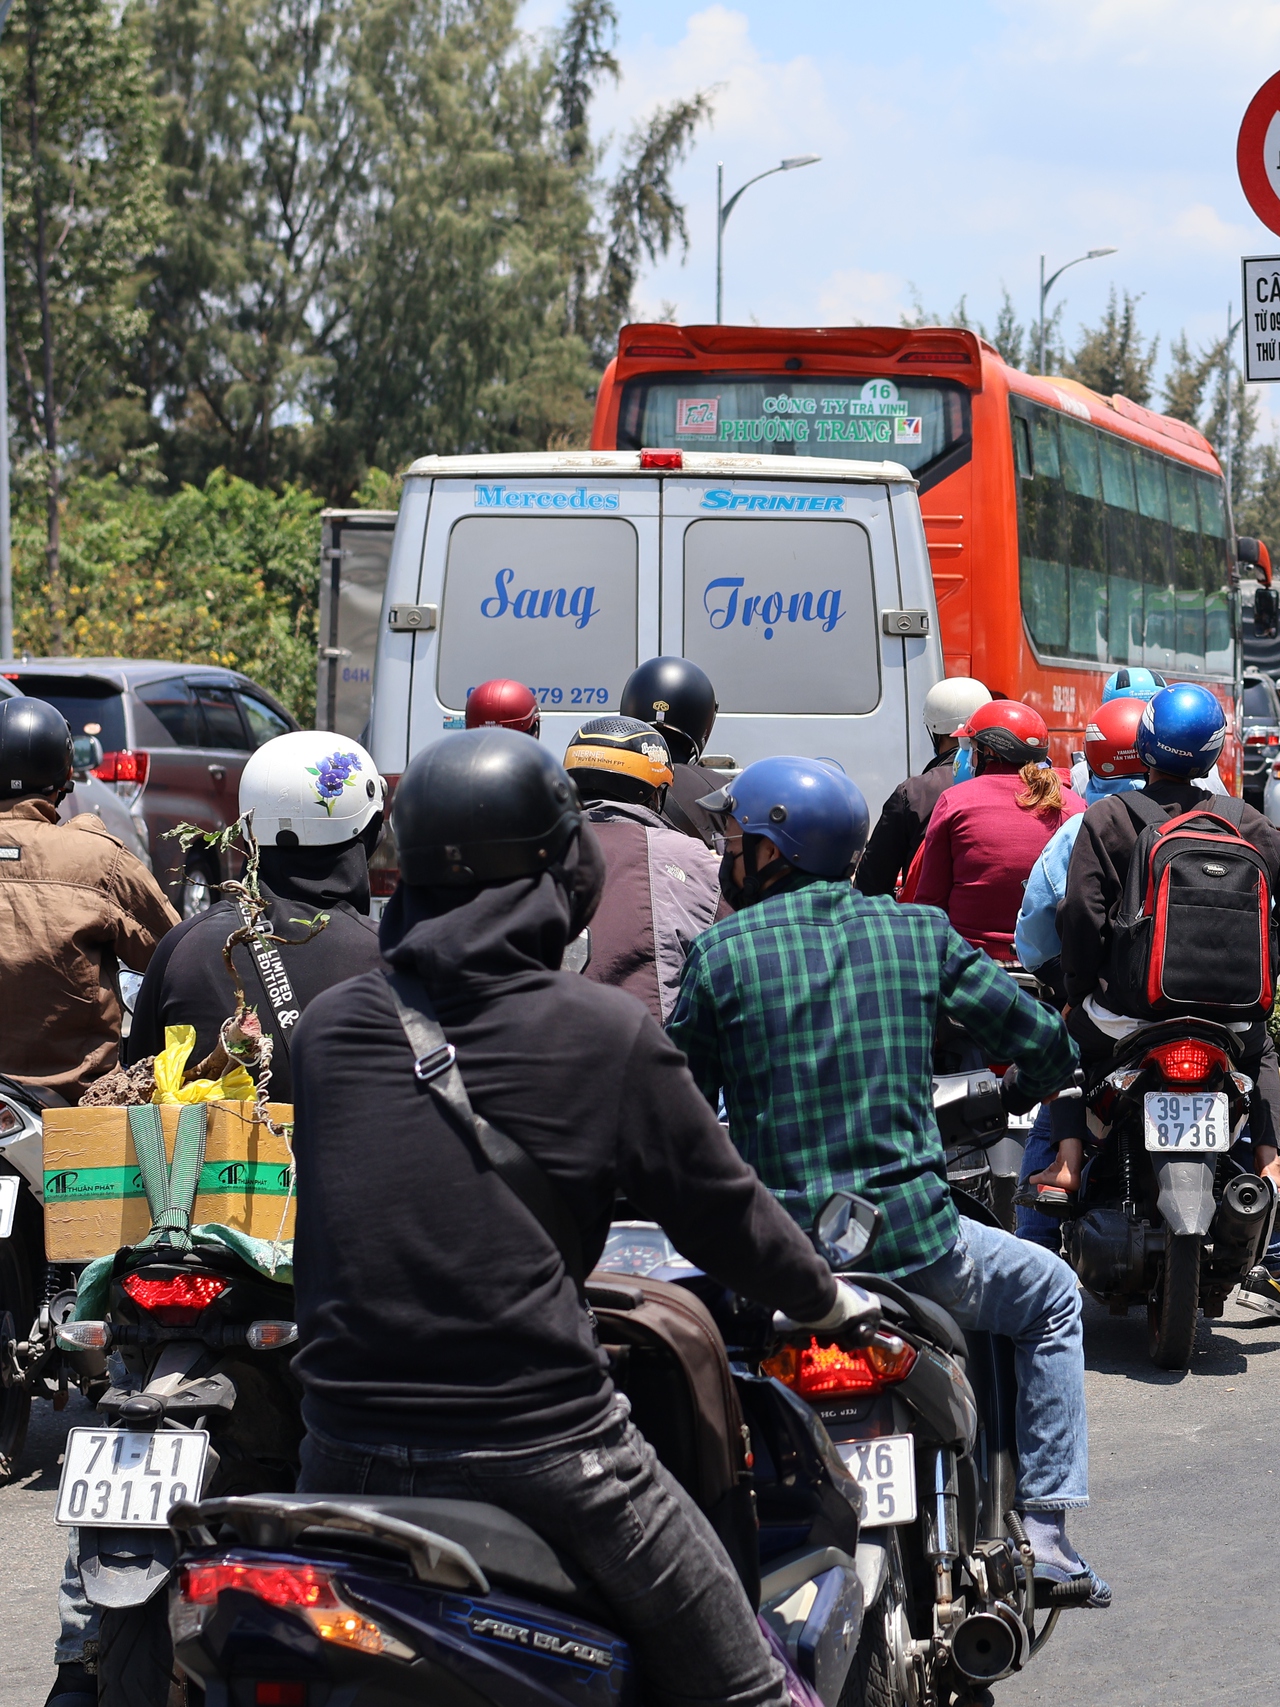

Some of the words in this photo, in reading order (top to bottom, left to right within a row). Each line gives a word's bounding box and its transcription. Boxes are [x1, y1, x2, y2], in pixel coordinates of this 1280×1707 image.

[1254, 309, 1268, 332] TỪ
[1256, 338, 1276, 362] THỨ
[763, 393, 816, 414] CÔNG
[820, 398, 849, 414] TY
[869, 384, 891, 399] 16
[852, 401, 874, 415] TRÀ
[879, 404, 906, 415] VINH
[719, 416, 809, 442] PHƯƠNG
[815, 419, 892, 443] TRANG
[474, 485, 619, 511] Mercedes
[700, 488, 845, 512] SPRINTER
[480, 568, 600, 630] Sang
[703, 577, 847, 641] Trọng
[342, 667, 370, 683] 84H
[571, 687, 609, 704] 279
[1157, 742, 1193, 757] HONDA
[257, 952, 284, 1008] EDITION
[268, 949, 293, 1002] LIMITED
[277, 1009, 300, 1029] &
[1157, 1096, 1216, 1122] 39-F2
[1157, 1122, 1217, 1148] 8736
[84, 1435, 184, 1476] 71-L1
[533, 1631, 613, 1666] BLADE
